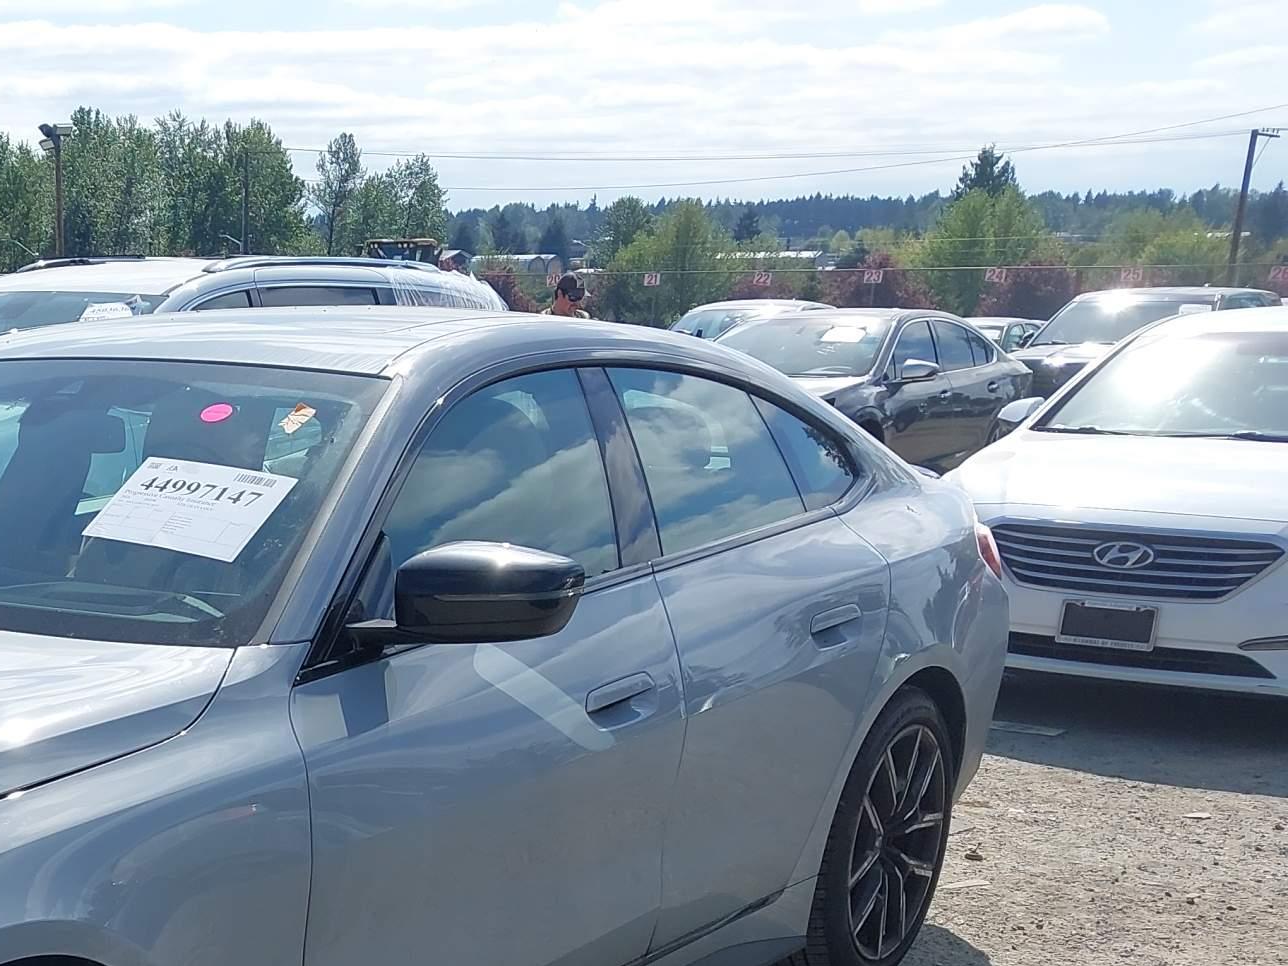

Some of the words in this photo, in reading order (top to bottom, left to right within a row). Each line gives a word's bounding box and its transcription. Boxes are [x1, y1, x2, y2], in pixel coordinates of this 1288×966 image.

[645, 274, 660, 286] 21
[755, 273, 771, 286] 22
[864, 270, 882, 283] 23
[986, 268, 1005, 282] 24
[1122, 268, 1143, 281] 25
[140, 476, 265, 508] 44997147
